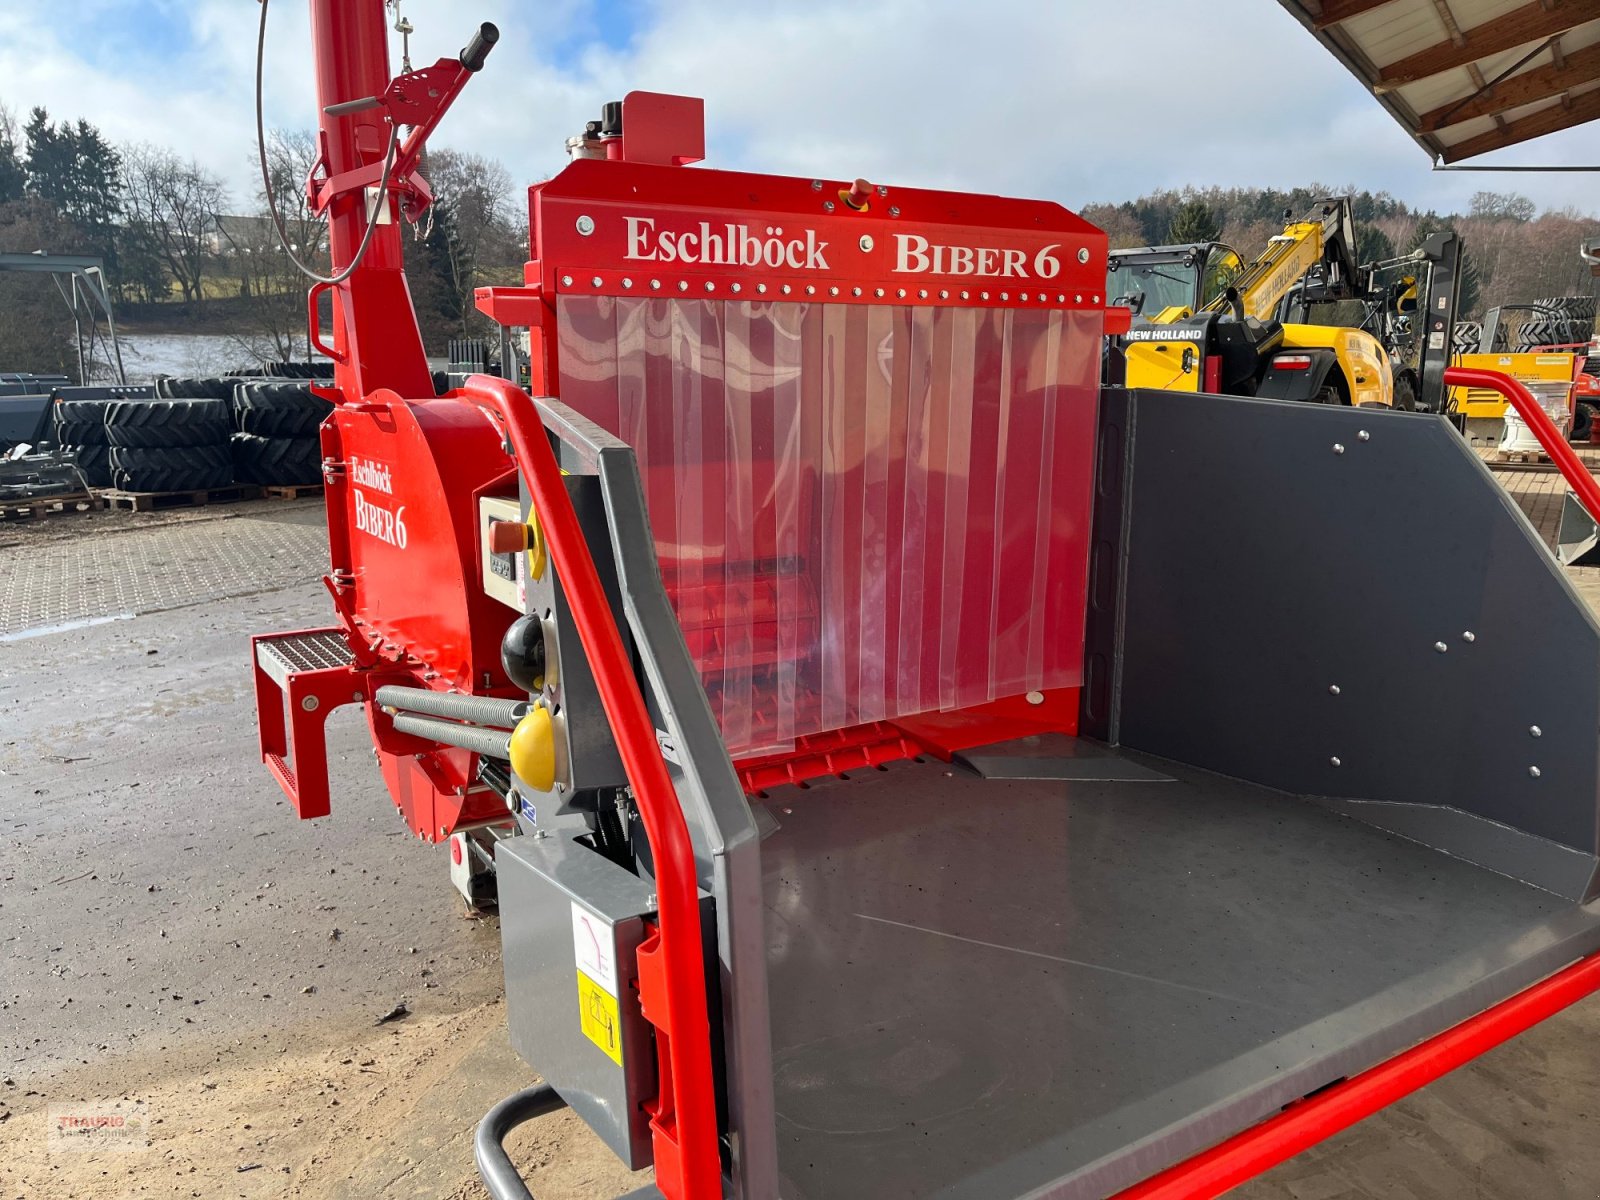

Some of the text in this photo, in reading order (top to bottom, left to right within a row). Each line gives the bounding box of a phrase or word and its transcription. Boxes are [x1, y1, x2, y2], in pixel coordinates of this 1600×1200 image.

[622, 216, 1062, 279] Eschlböck BIBER 6
[1126, 330, 1202, 340] NEW HOLLAND
[351, 455, 393, 495] Eschlböck
[353, 488, 407, 550] BIBER 6
